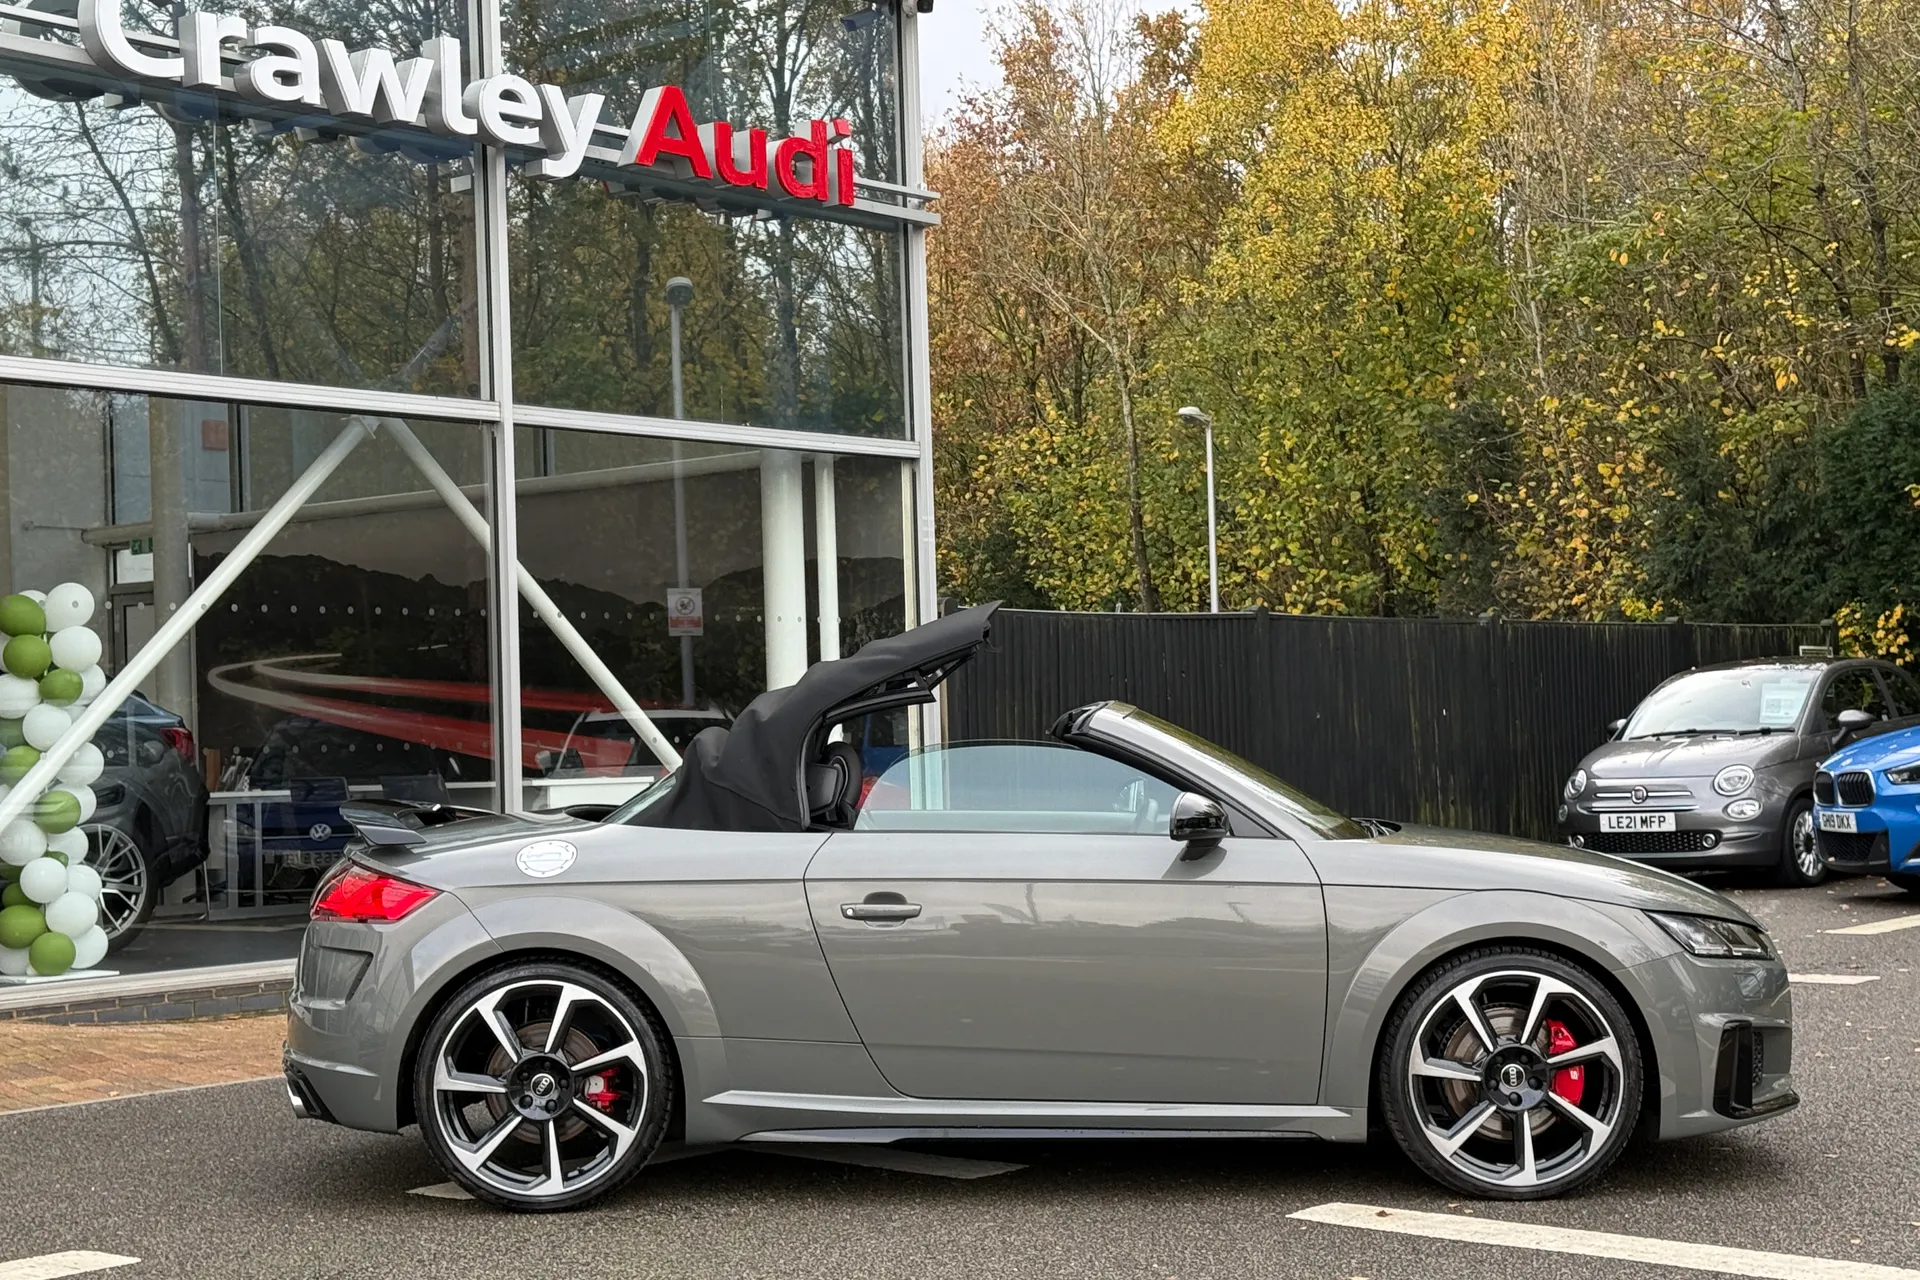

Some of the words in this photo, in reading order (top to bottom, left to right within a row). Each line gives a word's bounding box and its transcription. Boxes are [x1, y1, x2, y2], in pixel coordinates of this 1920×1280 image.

[85, 0, 605, 178] Crawley
[630, 84, 855, 206] Audi
[1608, 815, 1637, 829] LE21
[1640, 815, 1666, 829] MFP
[1835, 814, 1852, 830] DKX
